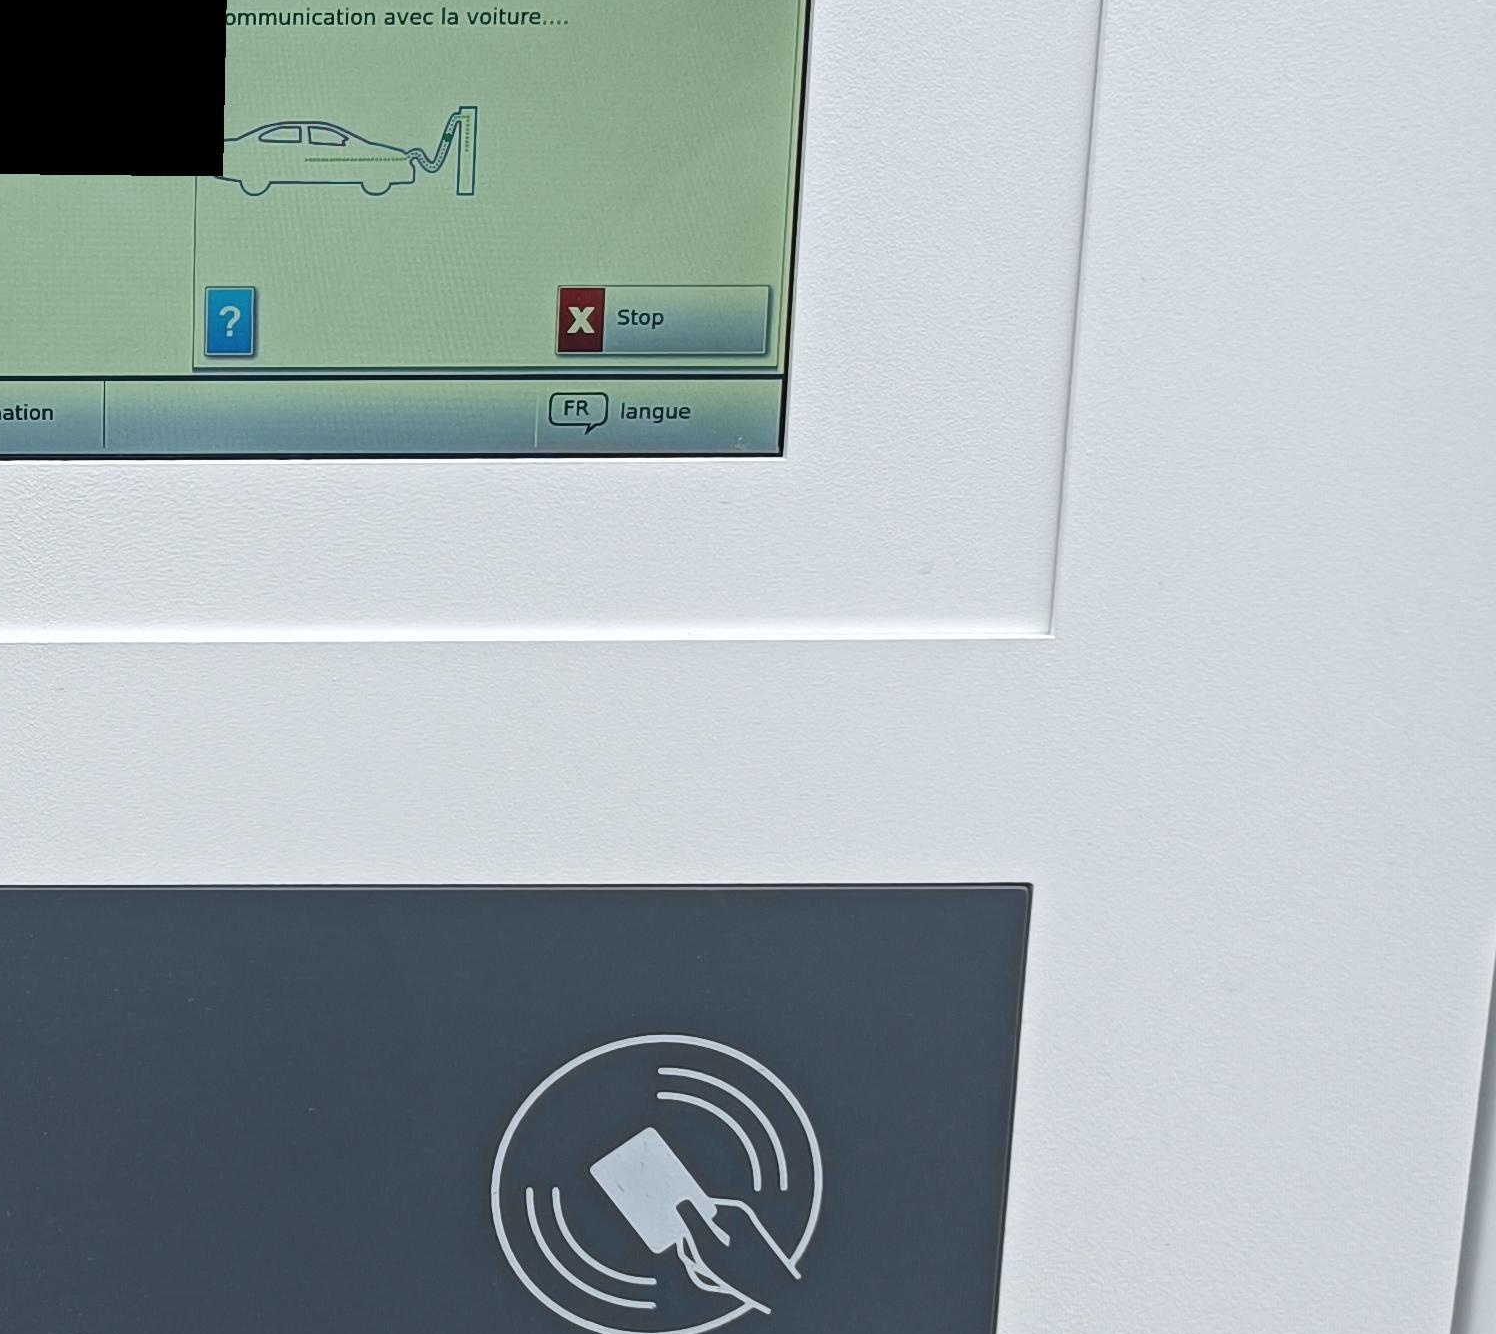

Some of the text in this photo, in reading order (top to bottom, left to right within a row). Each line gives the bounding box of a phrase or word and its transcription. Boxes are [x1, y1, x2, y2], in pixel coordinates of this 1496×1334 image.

[224, 5, 569, 26] ommunication avec la voiture....
[617, 309, 665, 330] Stop
[562, 400, 590, 417] FR
[620, 402, 691, 424] langue
